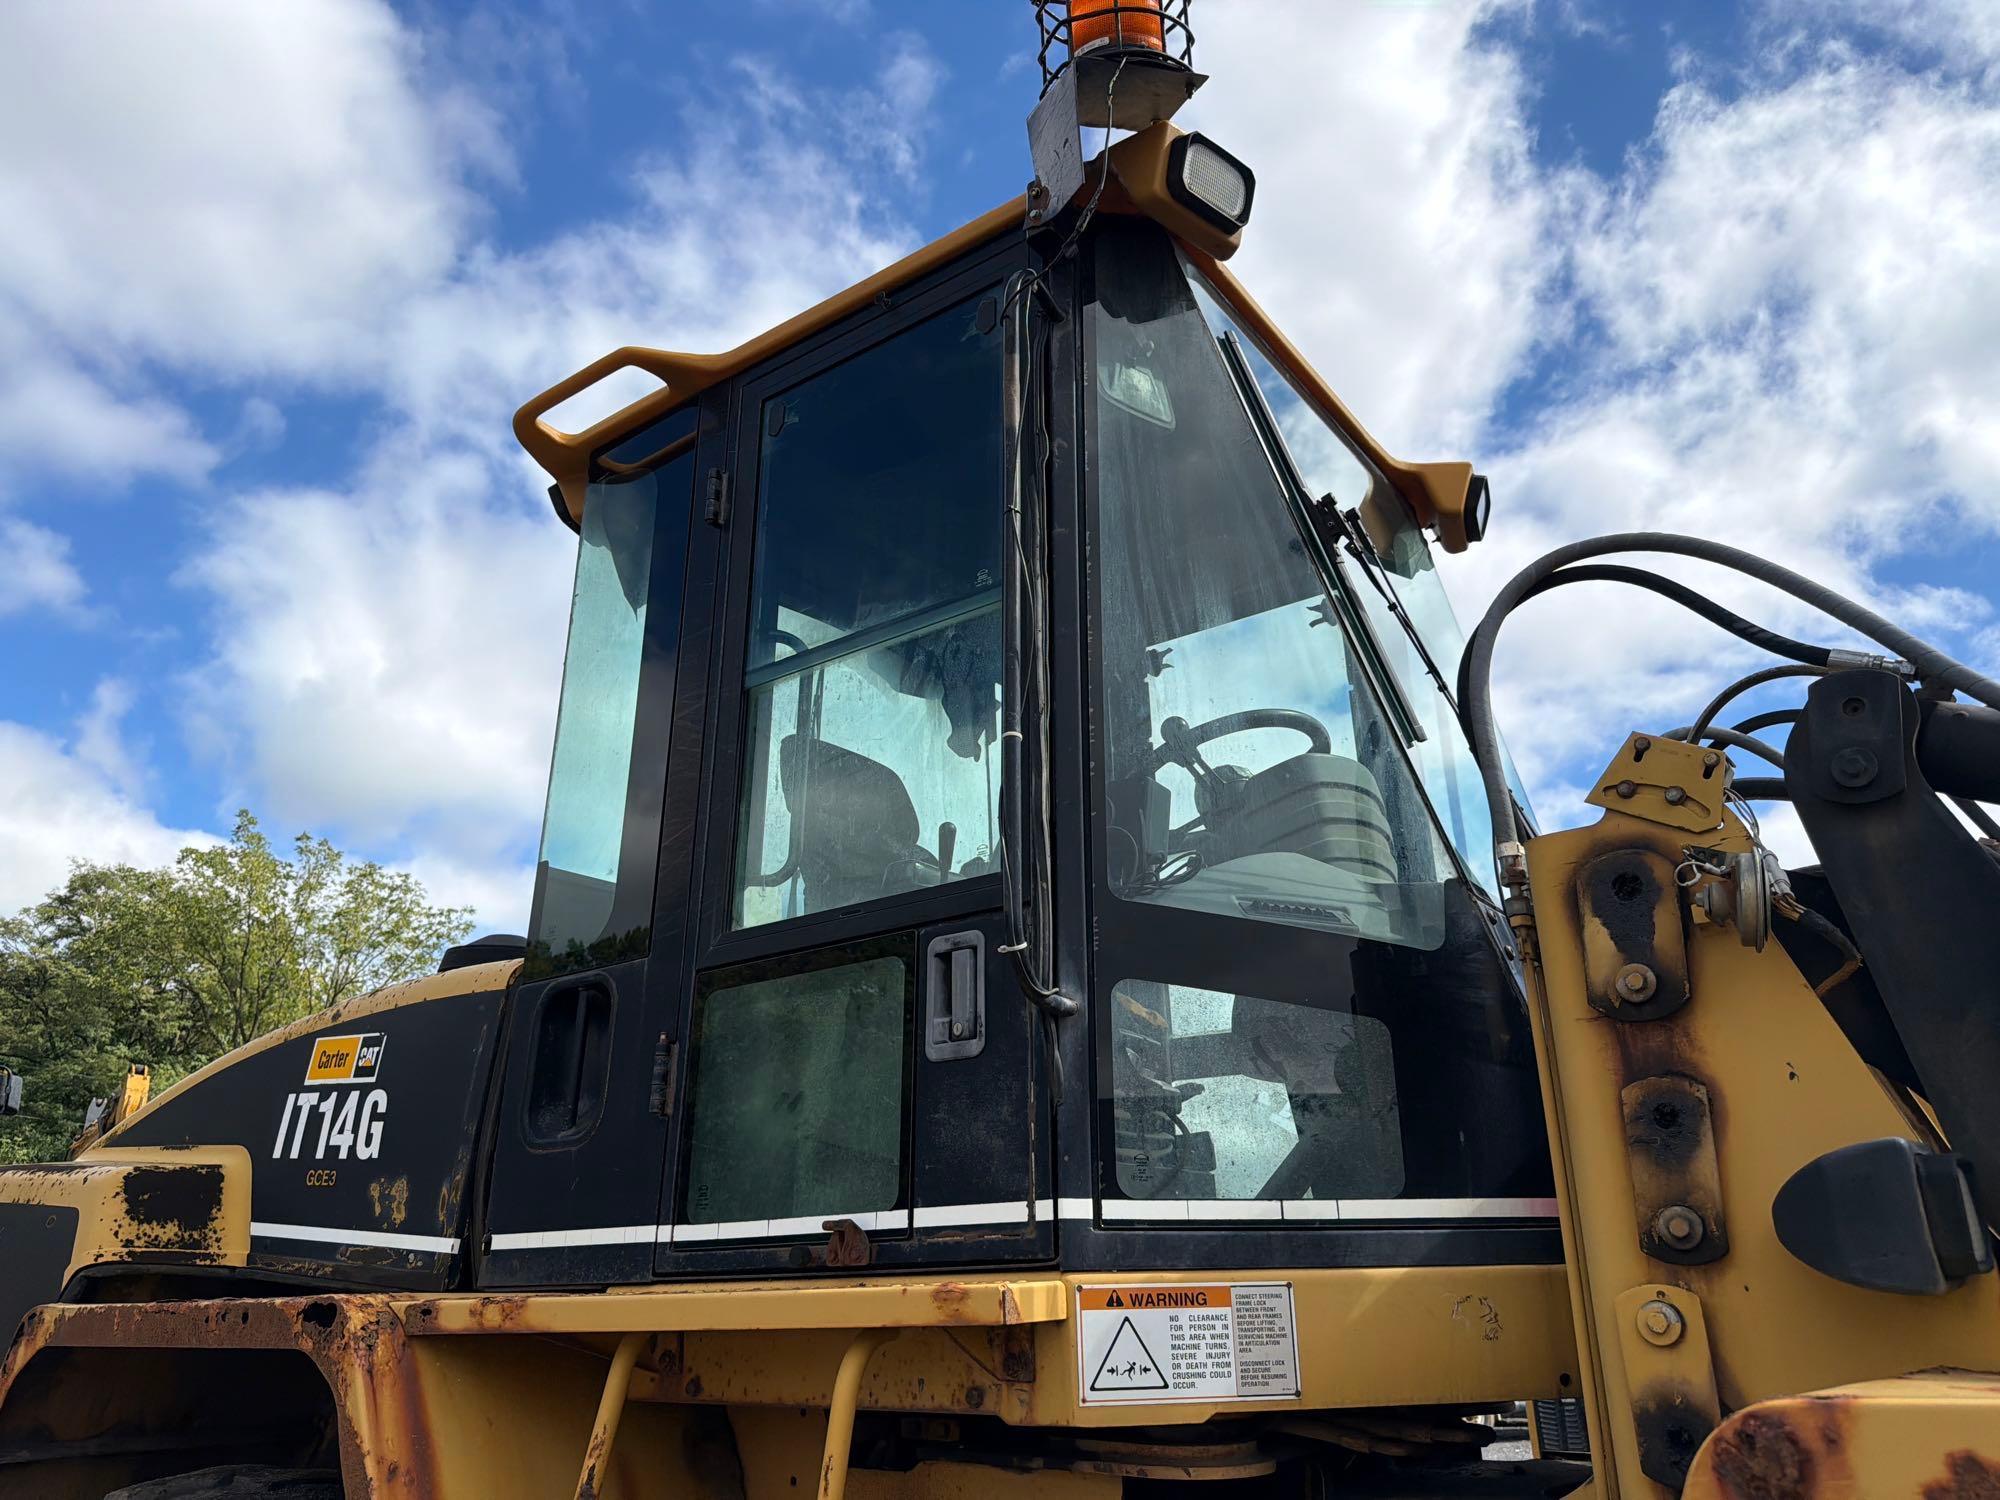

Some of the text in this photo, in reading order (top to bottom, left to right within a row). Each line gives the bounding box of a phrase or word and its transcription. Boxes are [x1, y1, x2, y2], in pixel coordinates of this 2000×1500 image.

[318, 1050, 349, 1069] Carter
[358, 1047, 380, 1067] CAT
[272, 1088, 388, 1160] IT14G
[306, 1170, 337, 1186] GCE3
[1129, 1292, 1208, 1307] WARNING
[1186, 1362, 1208, 1370] DEATH
[1212, 1361, 1232, 1369] FROM
[1172, 1372, 1207, 1380] CRUSHING
